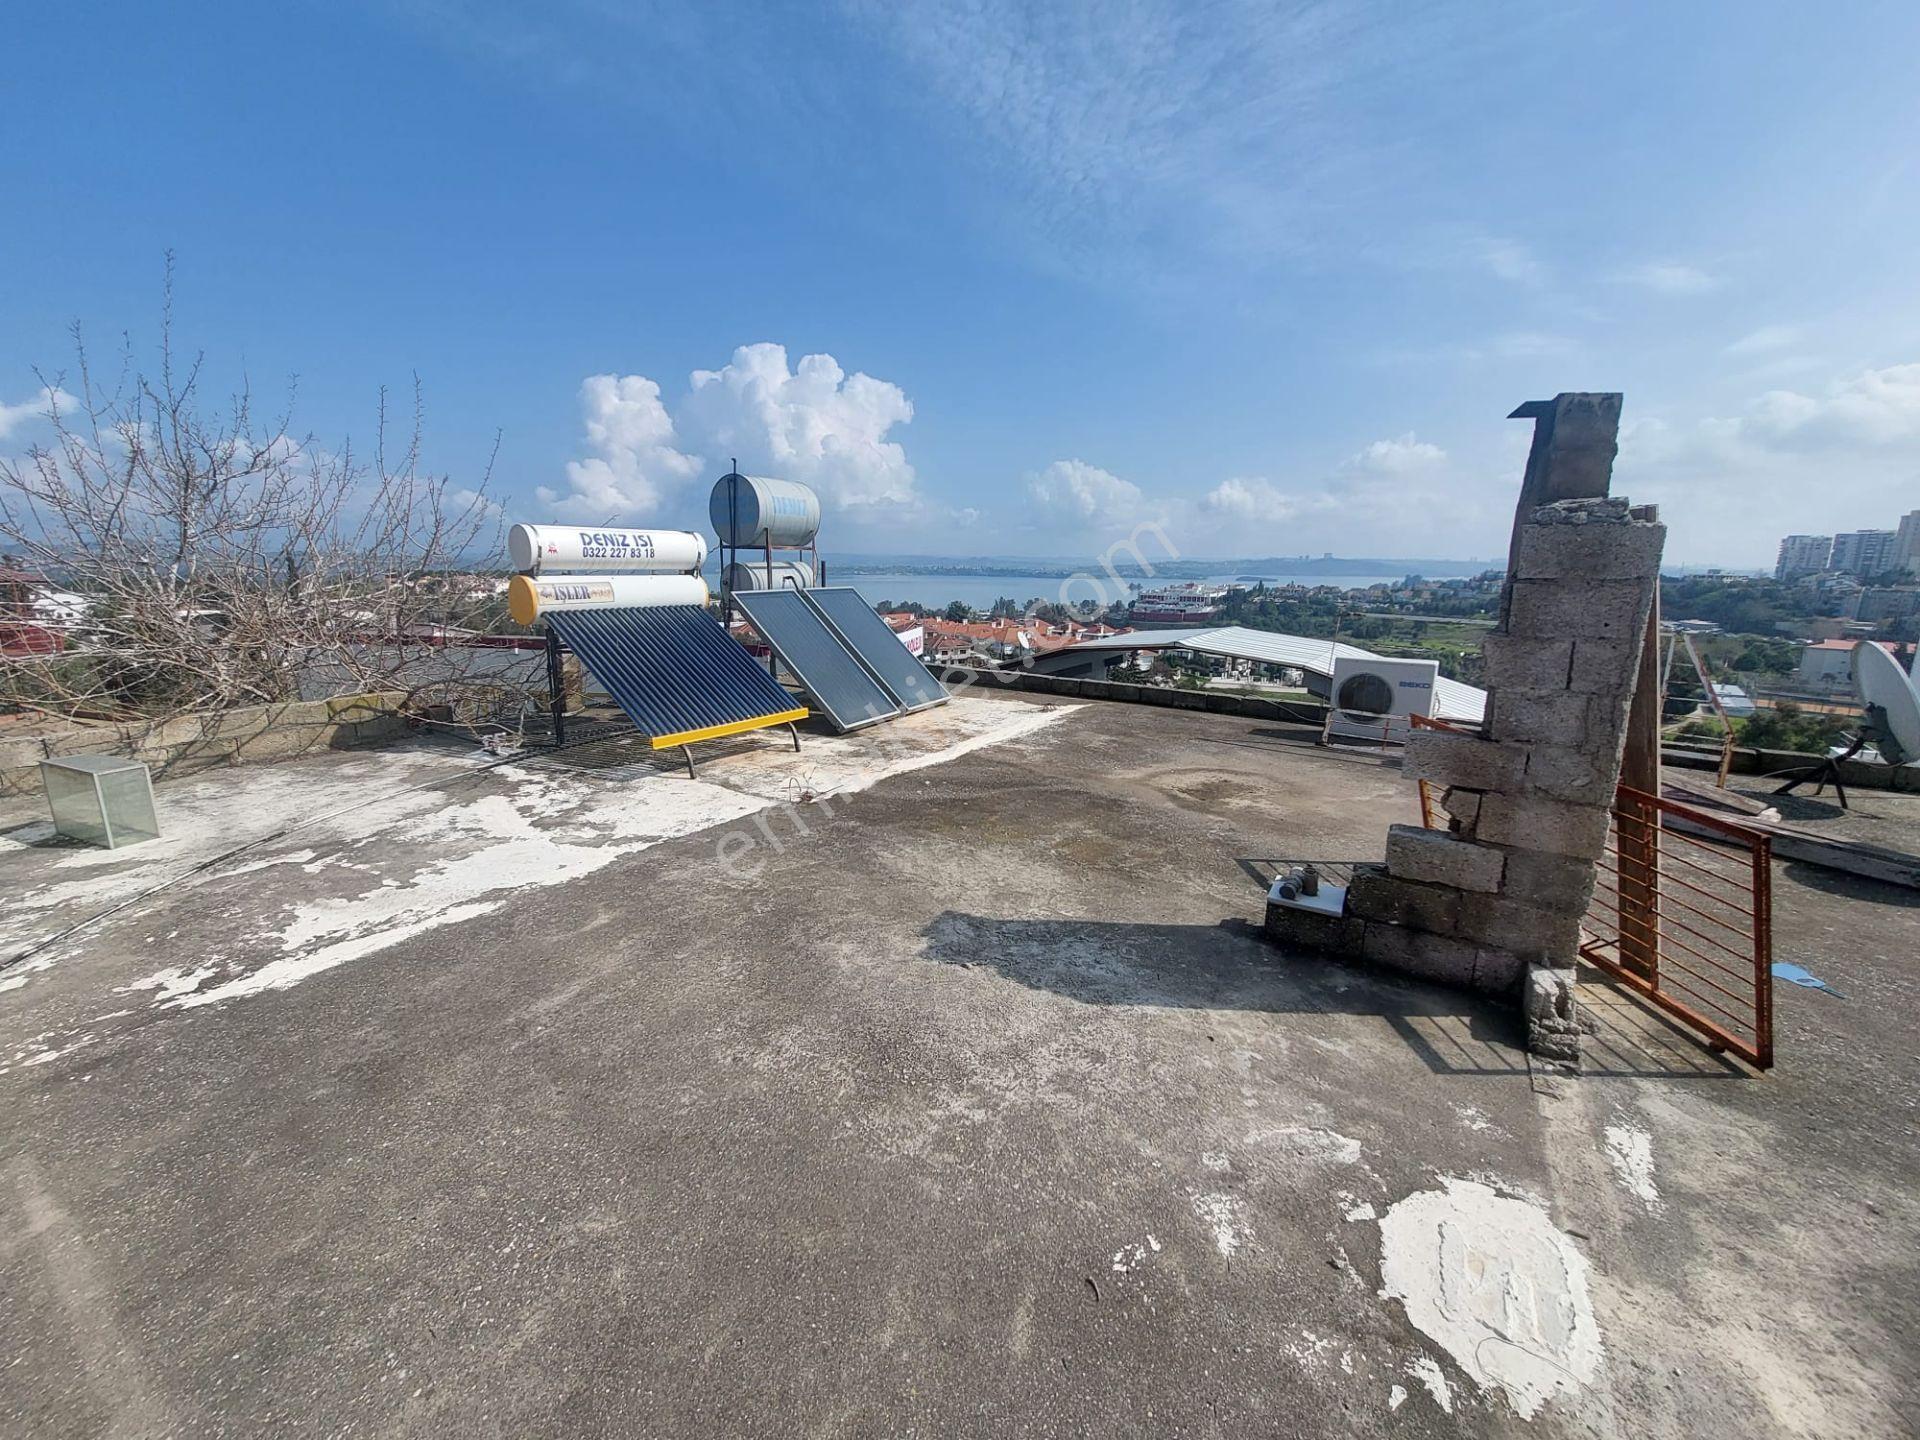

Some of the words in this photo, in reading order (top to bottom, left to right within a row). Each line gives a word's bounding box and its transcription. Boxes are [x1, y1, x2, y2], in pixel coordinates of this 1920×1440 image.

[582, 547, 606, 558] 0322
[610, 547, 627, 558] 227
[630, 548, 641, 558] 83
[645, 548, 655, 558] 18
